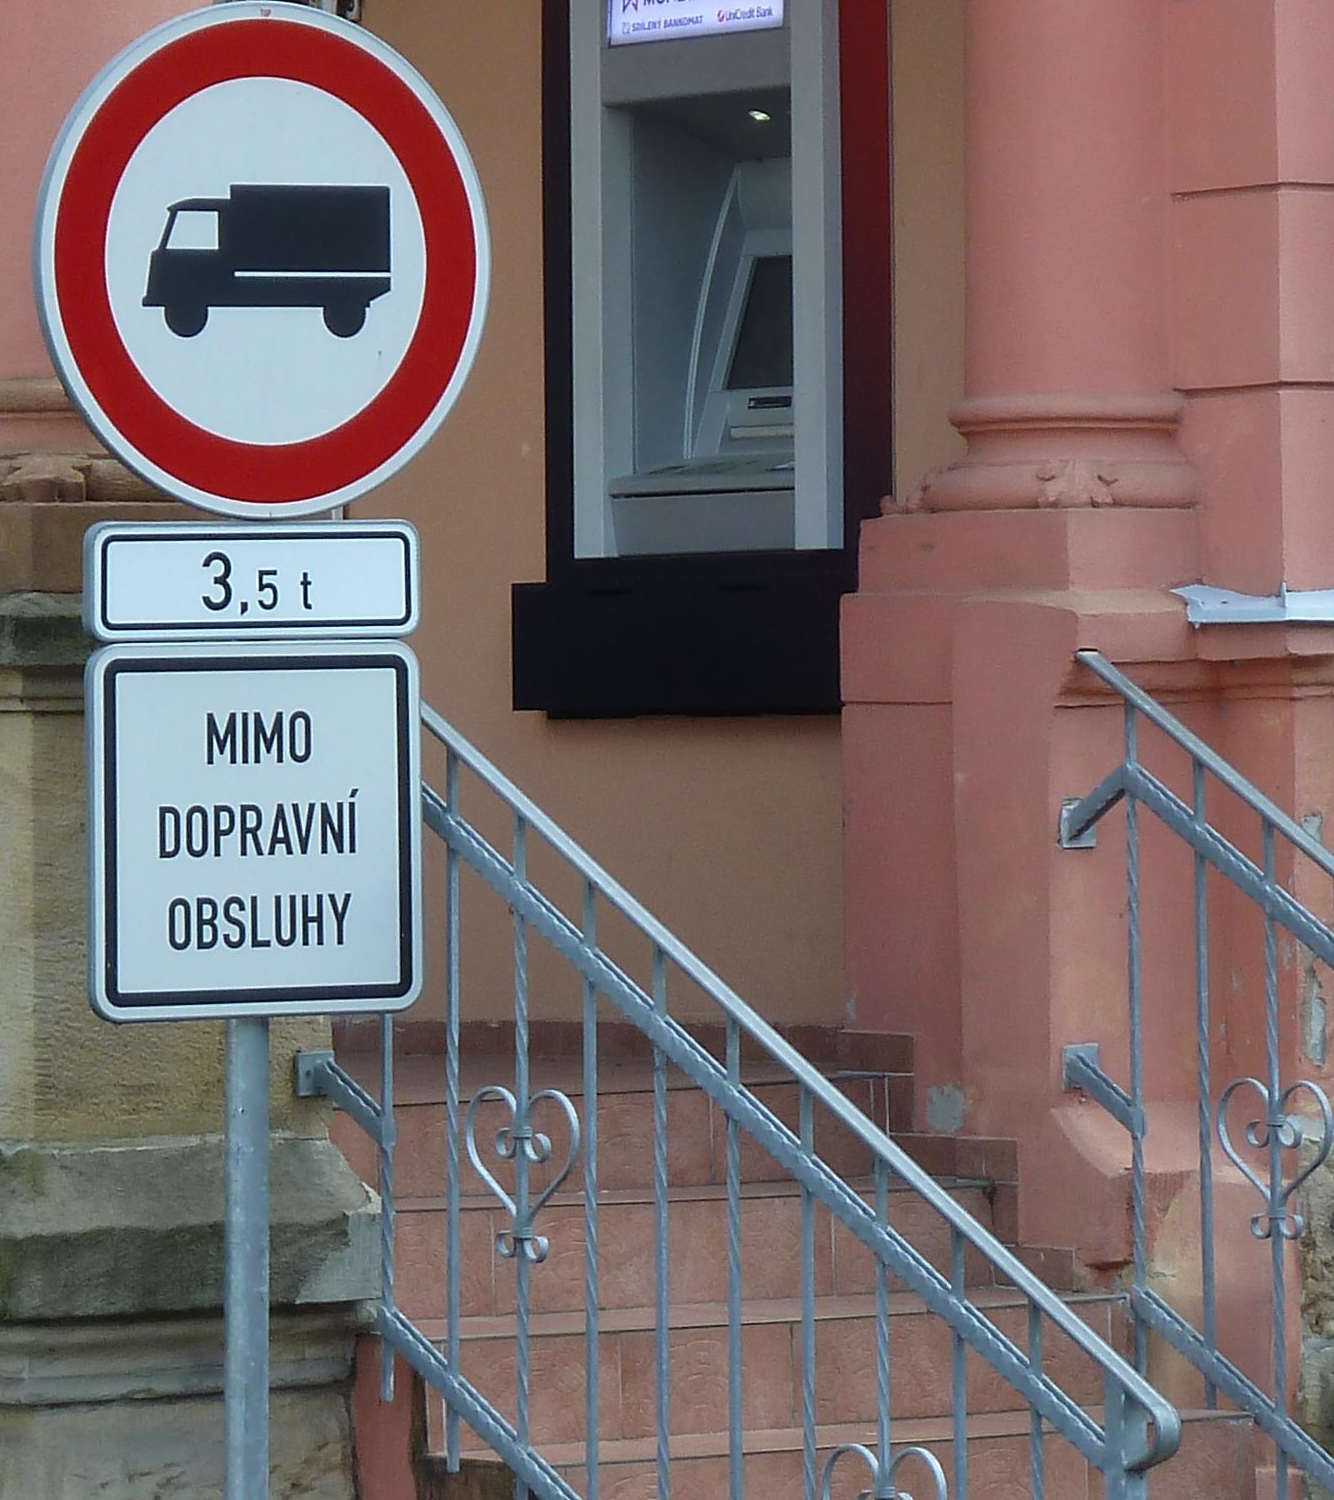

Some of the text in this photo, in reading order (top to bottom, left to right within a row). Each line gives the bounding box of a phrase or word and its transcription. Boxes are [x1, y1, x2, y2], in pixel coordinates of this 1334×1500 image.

[201, 551, 313, 616] 3,5 t
[206, 710, 313, 765] MIMO
[158, 788, 359, 859] DOPRAVNÍ
[168, 893, 352, 951] OBSLUHY
